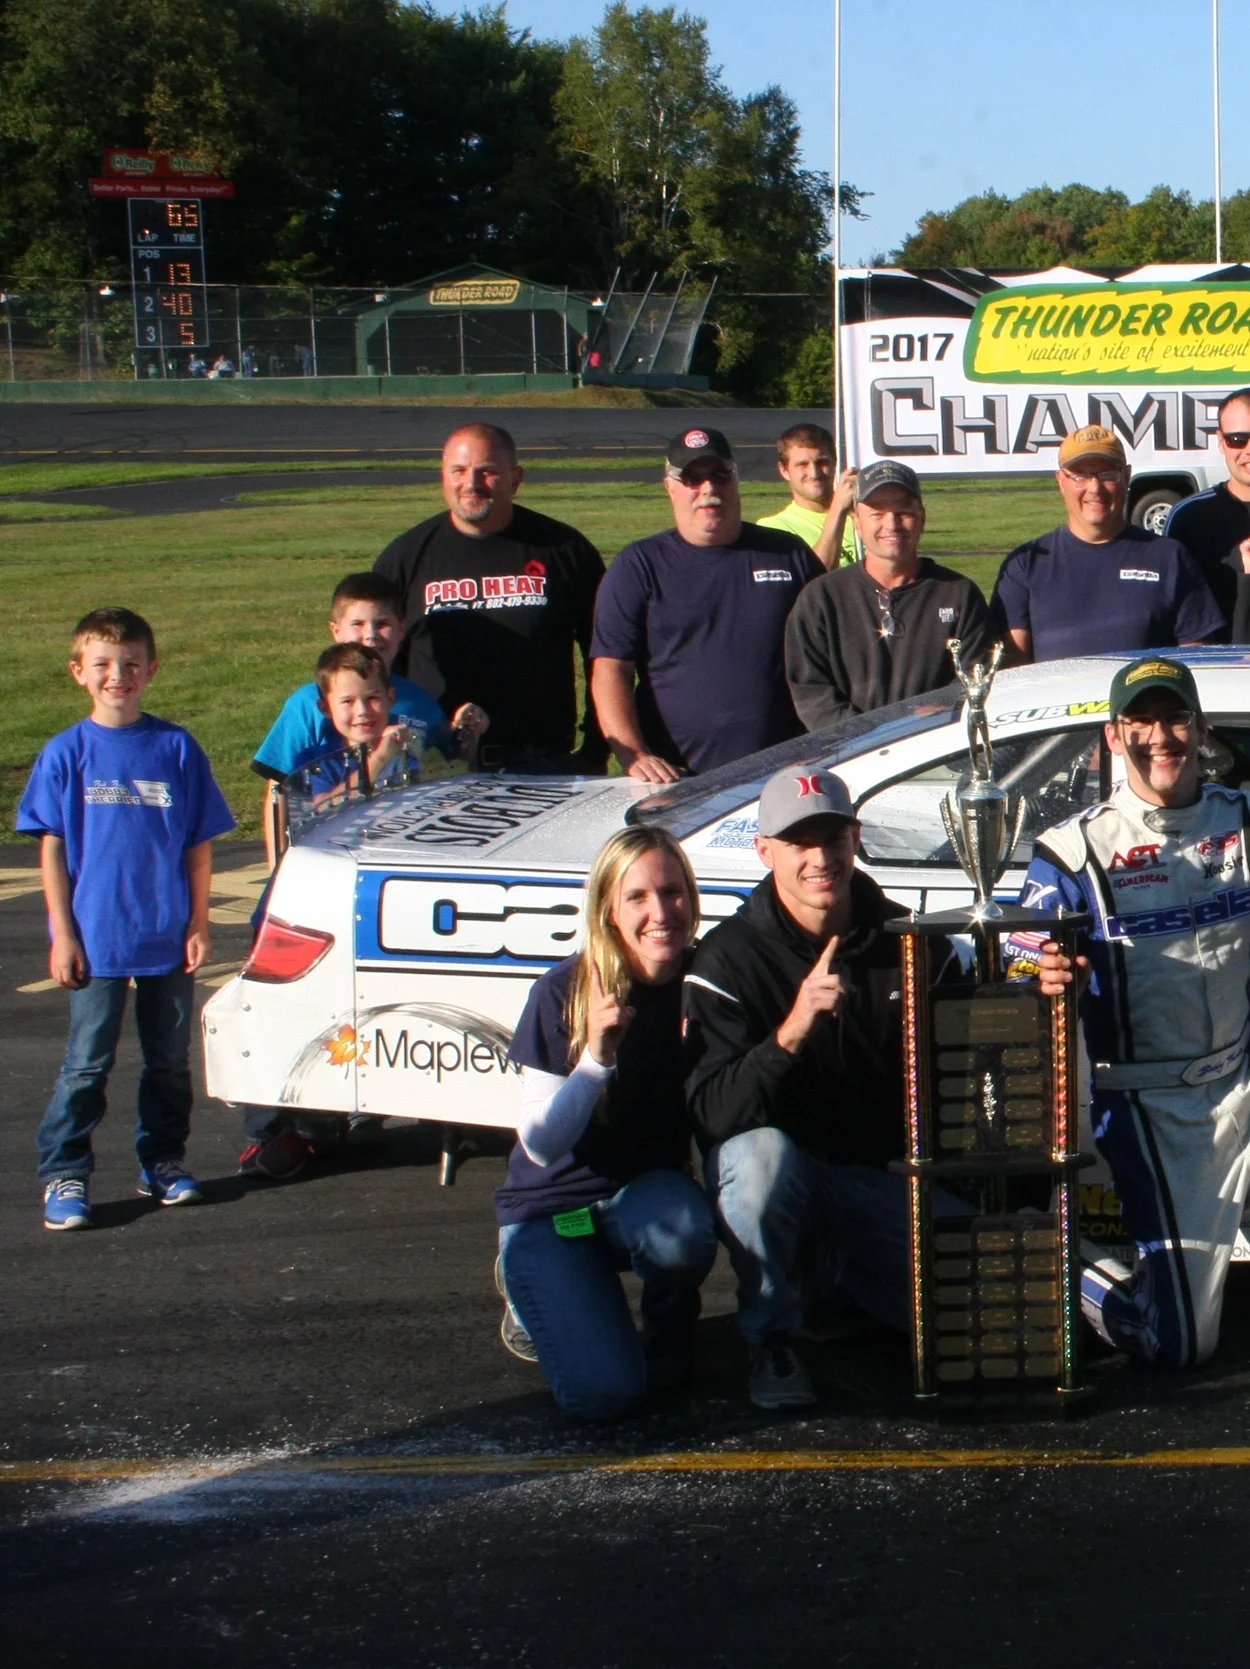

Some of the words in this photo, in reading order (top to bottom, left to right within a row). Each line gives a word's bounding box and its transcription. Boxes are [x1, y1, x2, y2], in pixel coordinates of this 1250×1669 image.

[167, 203, 199, 227] 65
[138, 233, 158, 243] LAP
[173, 233, 196, 243] TIME
[138, 249, 160, 259] POS
[143, 266, 151, 283] 1
[168, 263, 191, 286] 13
[144, 296, 154, 313] 2
[162, 293, 193, 315] 40
[436, 286, 483, 300] THUNDER
[484, 285, 514, 298] ROAD
[992, 303, 1174, 340] THUNDER
[146, 326, 156, 343] 3
[180, 323, 194, 345] 5
[869, 333, 955, 363] 2017
[1100, 342, 1130, 362] site
[1136, 342, 1156, 364] of
[425, 579, 478, 606] PRO
[482, 575, 546, 599] HEAT
[405, 784, 584, 848] DUBOIS
[1109, 843, 1163, 873] ACT
